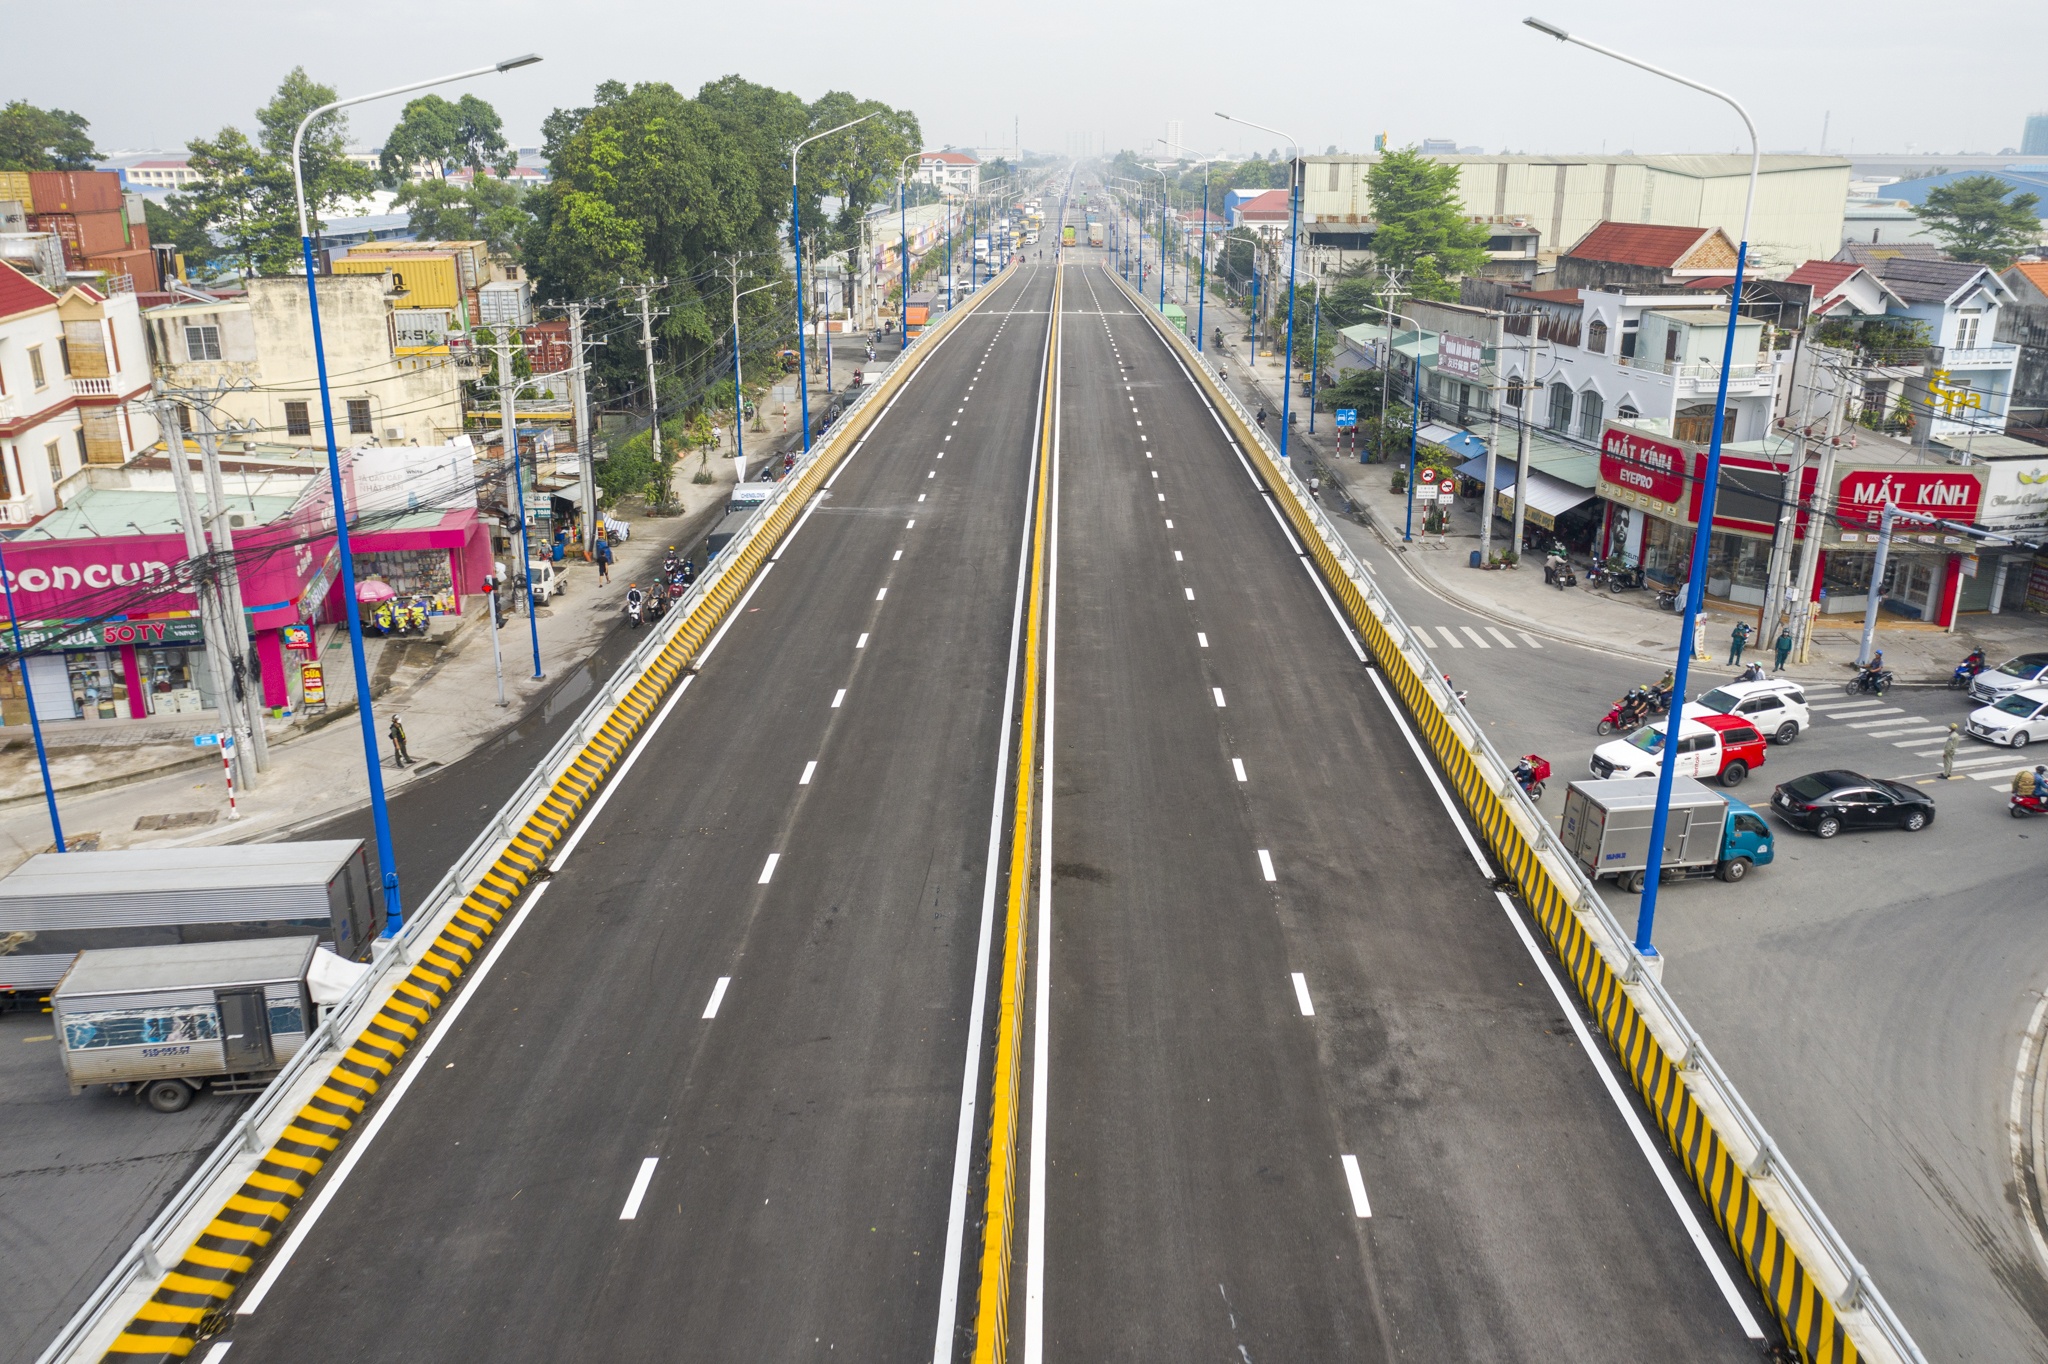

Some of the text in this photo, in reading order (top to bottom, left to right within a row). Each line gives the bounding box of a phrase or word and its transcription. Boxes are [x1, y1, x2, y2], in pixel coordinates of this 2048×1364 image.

[1923, 377, 1981, 415] Spa
[1607, 434, 1672, 476] MẮT KÍNH
[1620, 468, 1653, 489] EYEPRO
[1854, 474, 1970, 505] MẮT KÍNH
